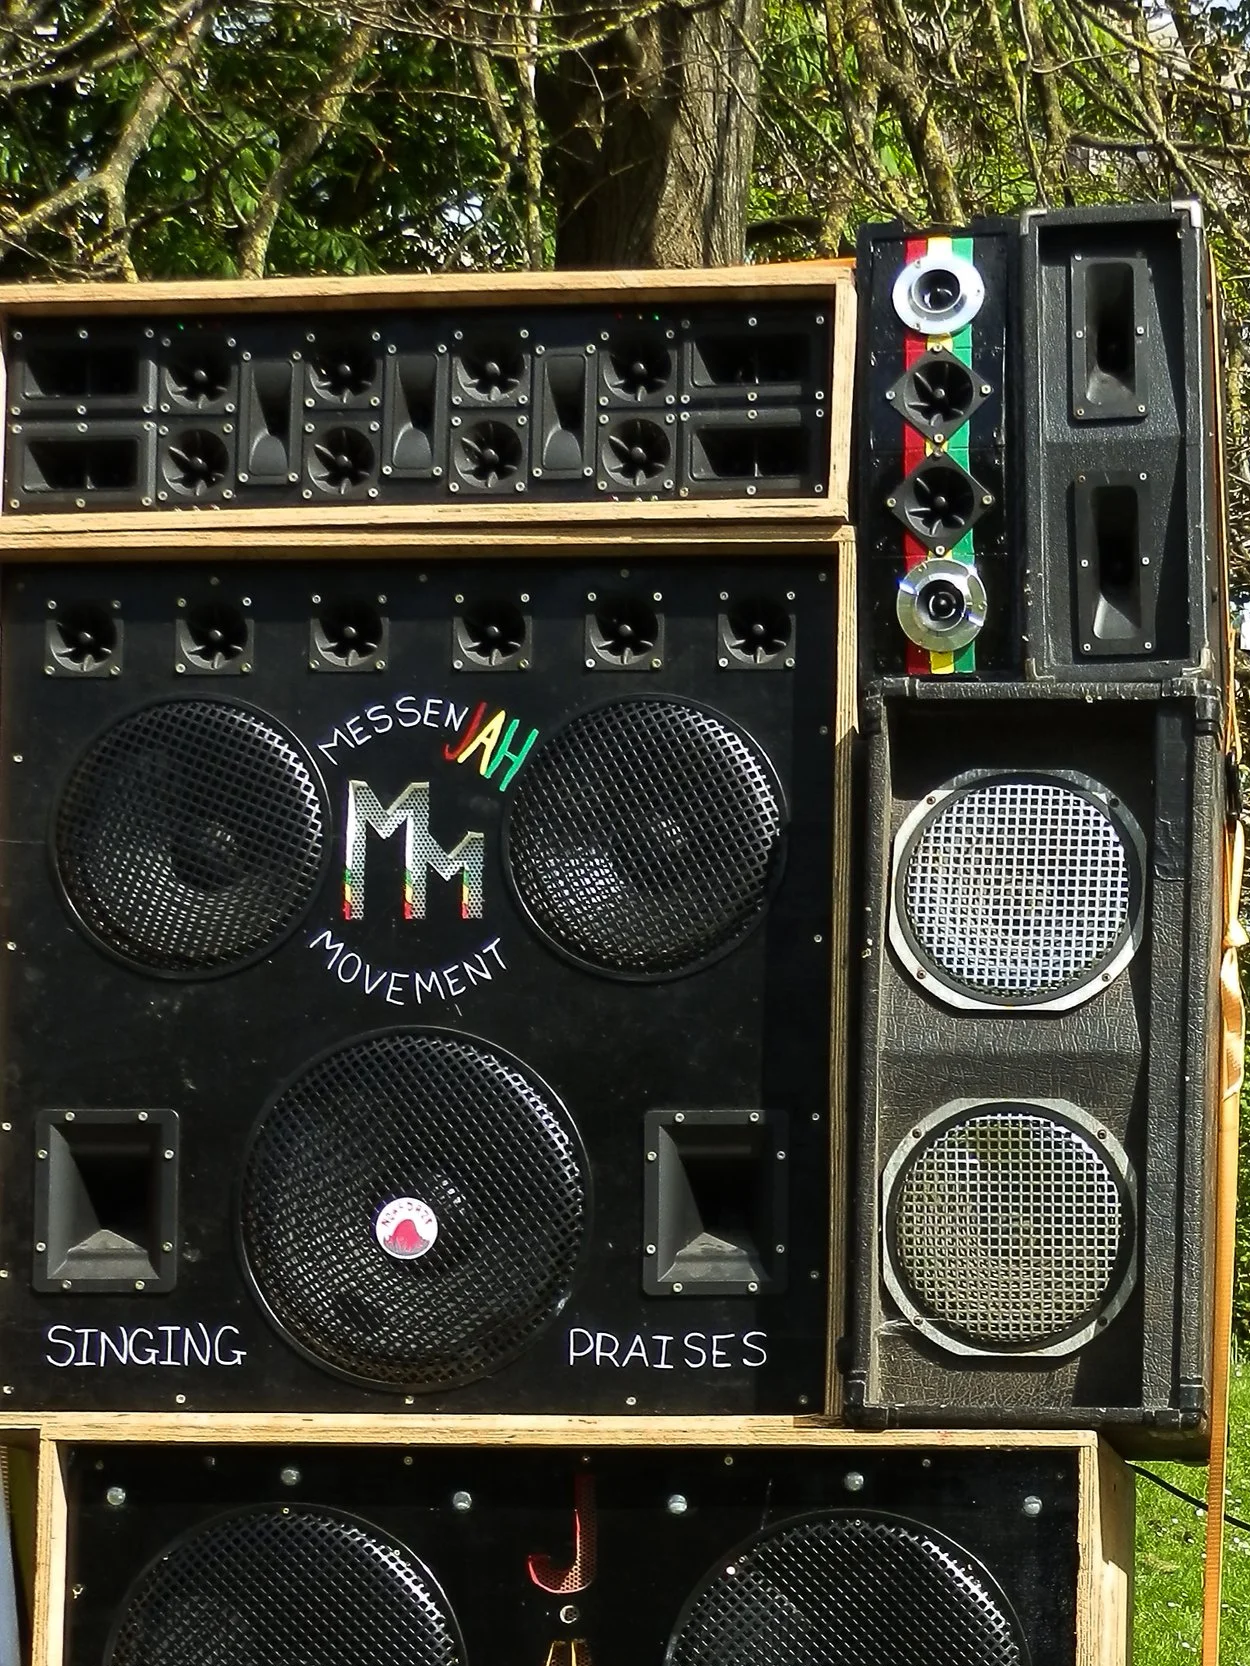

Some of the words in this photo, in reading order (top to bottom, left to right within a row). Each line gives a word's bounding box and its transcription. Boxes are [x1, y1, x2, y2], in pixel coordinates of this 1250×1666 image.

[317, 696, 539, 792] MESSENJAH
[309, 930, 507, 1005] MOVEMENT
[46, 1324, 248, 1368] SINGING
[569, 1328, 769, 1369] PRAISES
